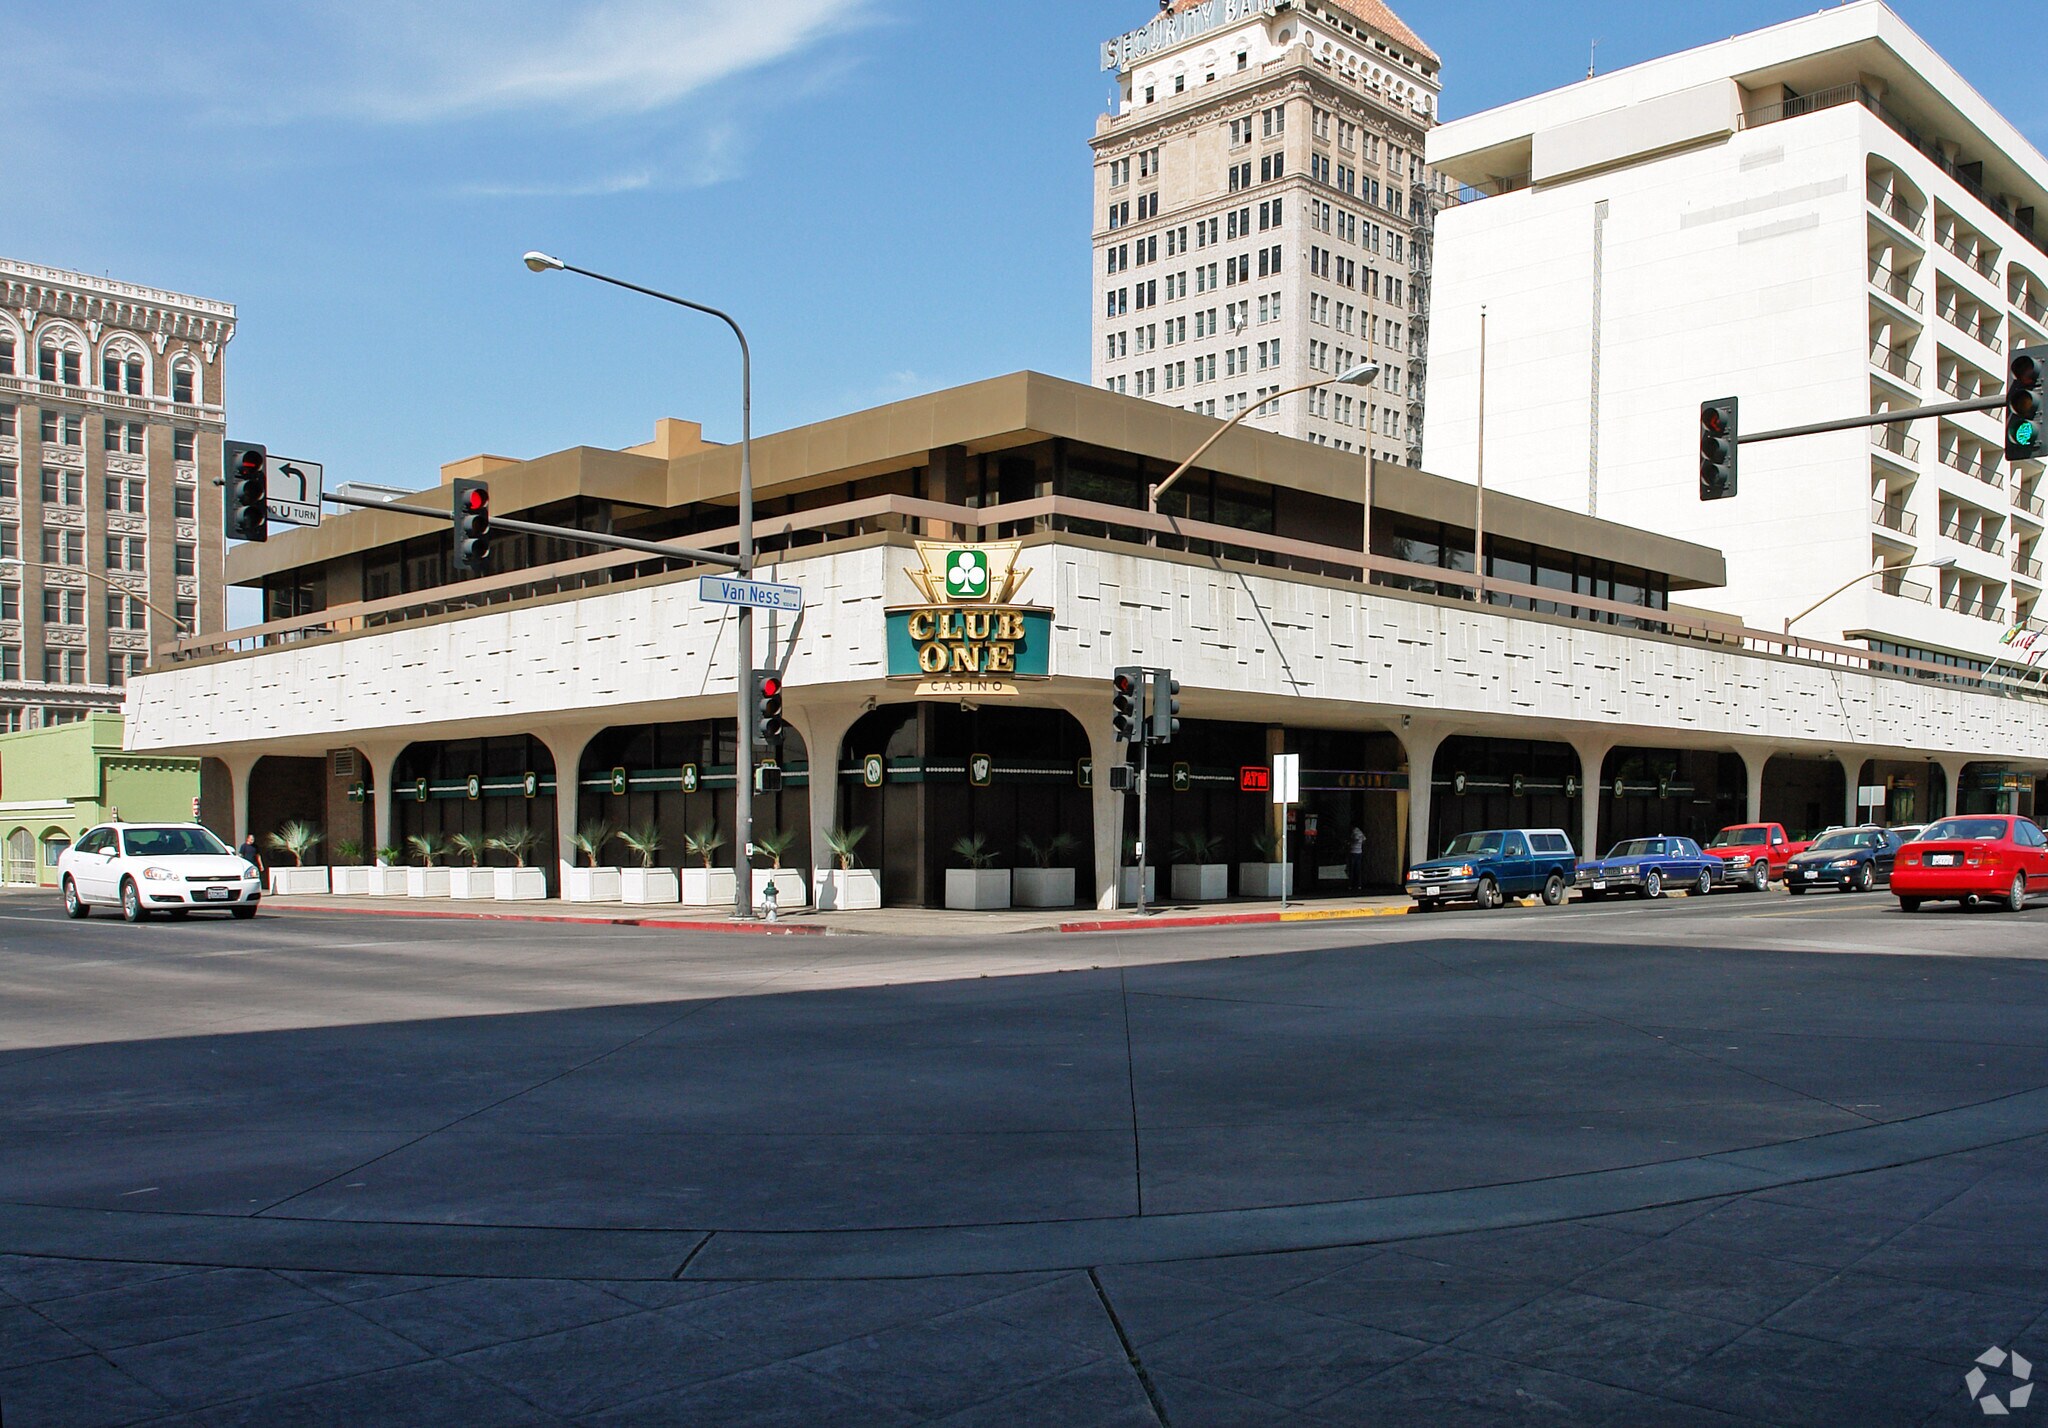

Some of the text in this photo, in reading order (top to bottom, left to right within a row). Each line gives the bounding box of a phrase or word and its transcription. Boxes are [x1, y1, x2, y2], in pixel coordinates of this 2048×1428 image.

[1106, 1, 1214, 70] SECURITY
[281, 505, 290, 517] U
[294, 508, 316, 520] TURN
[722, 582, 780, 605] Van Ness
[908, 609, 1025, 640] CLUB
[918, 641, 1015, 672] ONE
[930, 681, 1003, 691] CASINO
[1243, 771, 1267, 787] ATM
